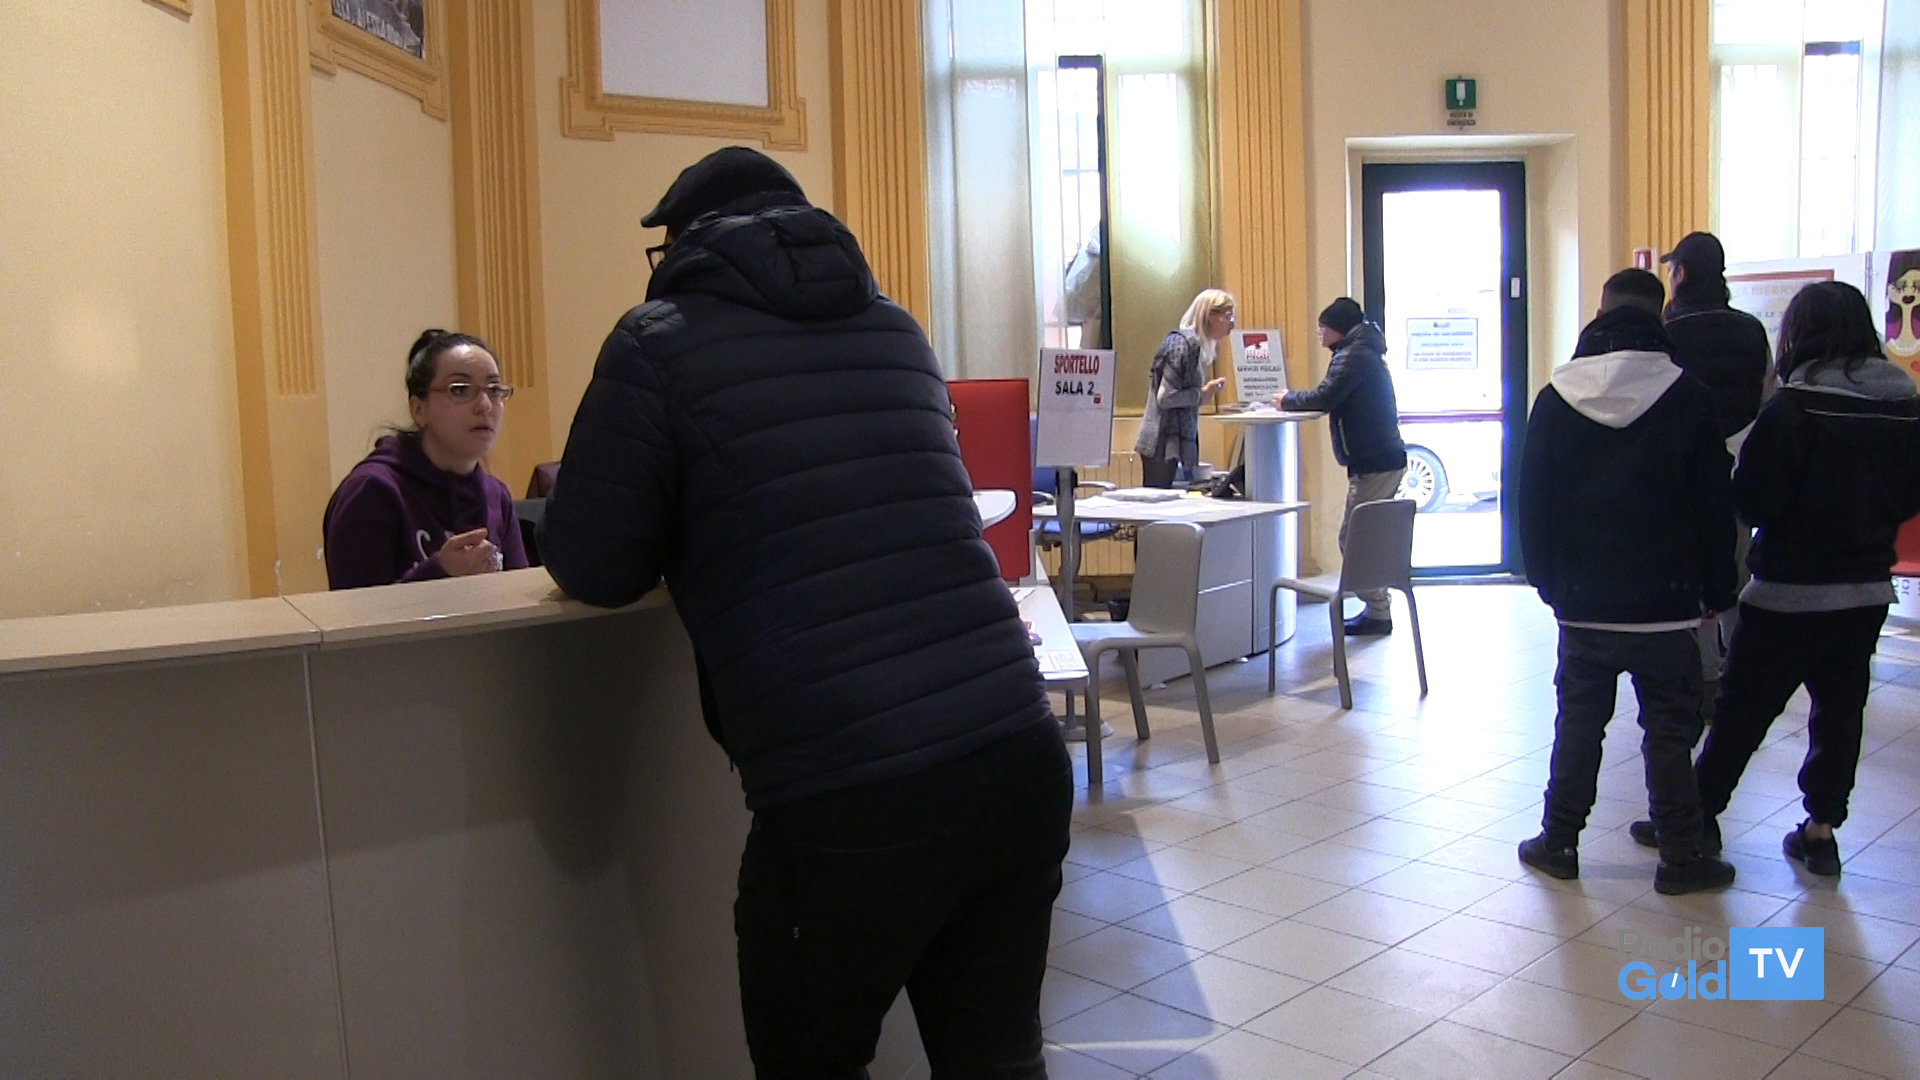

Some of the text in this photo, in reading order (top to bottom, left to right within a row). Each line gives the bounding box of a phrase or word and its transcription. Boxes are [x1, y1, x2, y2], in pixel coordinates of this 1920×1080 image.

[1054, 353, 1100, 375] SPORTELLO
[1055, 380, 1095, 396] SALA 2
